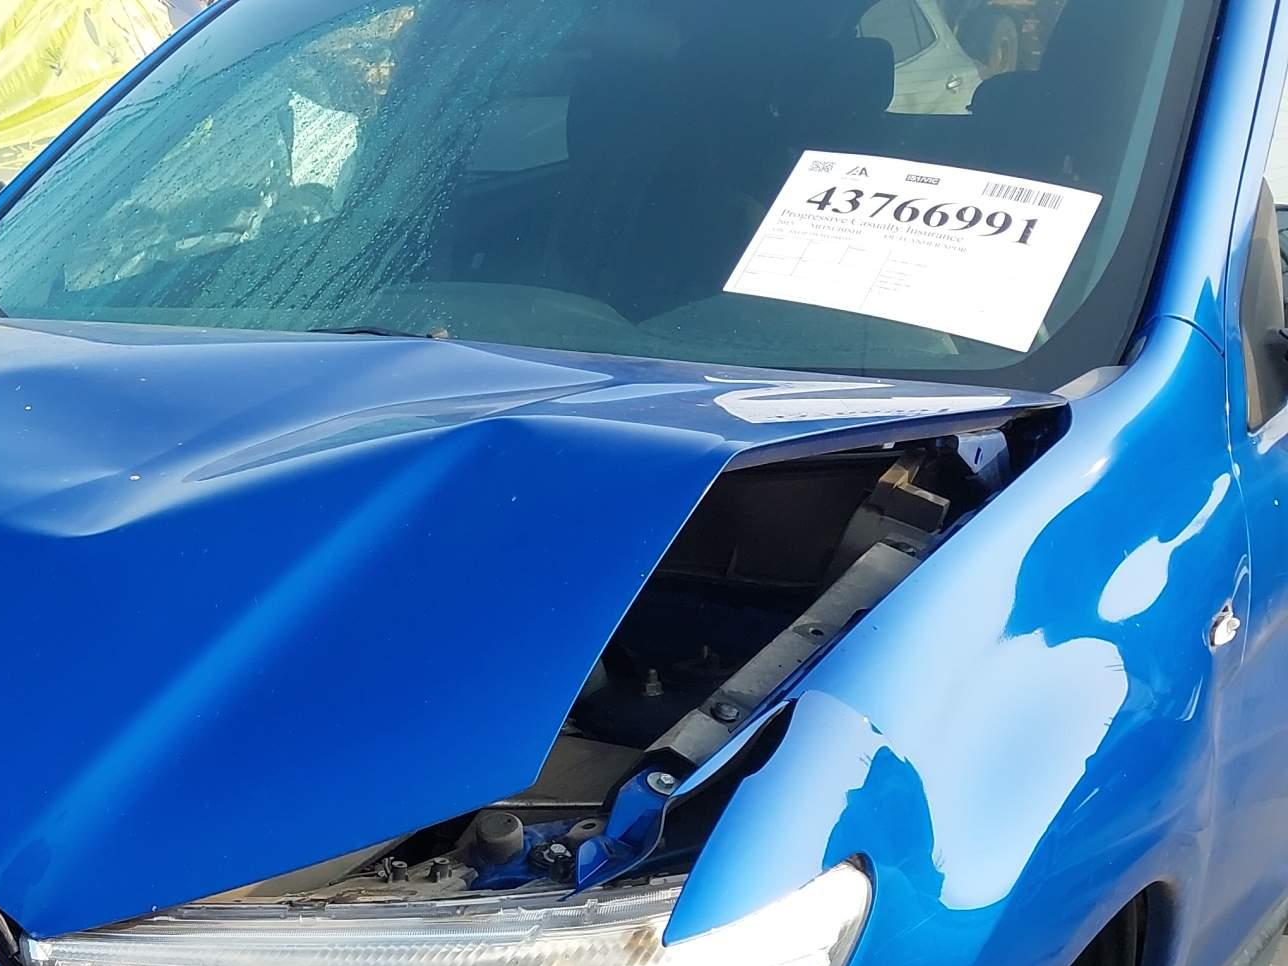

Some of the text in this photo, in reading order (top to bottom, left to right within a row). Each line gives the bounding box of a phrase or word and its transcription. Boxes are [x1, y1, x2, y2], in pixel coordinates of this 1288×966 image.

[780, 208, 849, 225] Progressive
[850, 218, 900, 234] Casualty
[905, 225, 964, 243] Insurance
[806, 186, 1038, 245] 43766991
